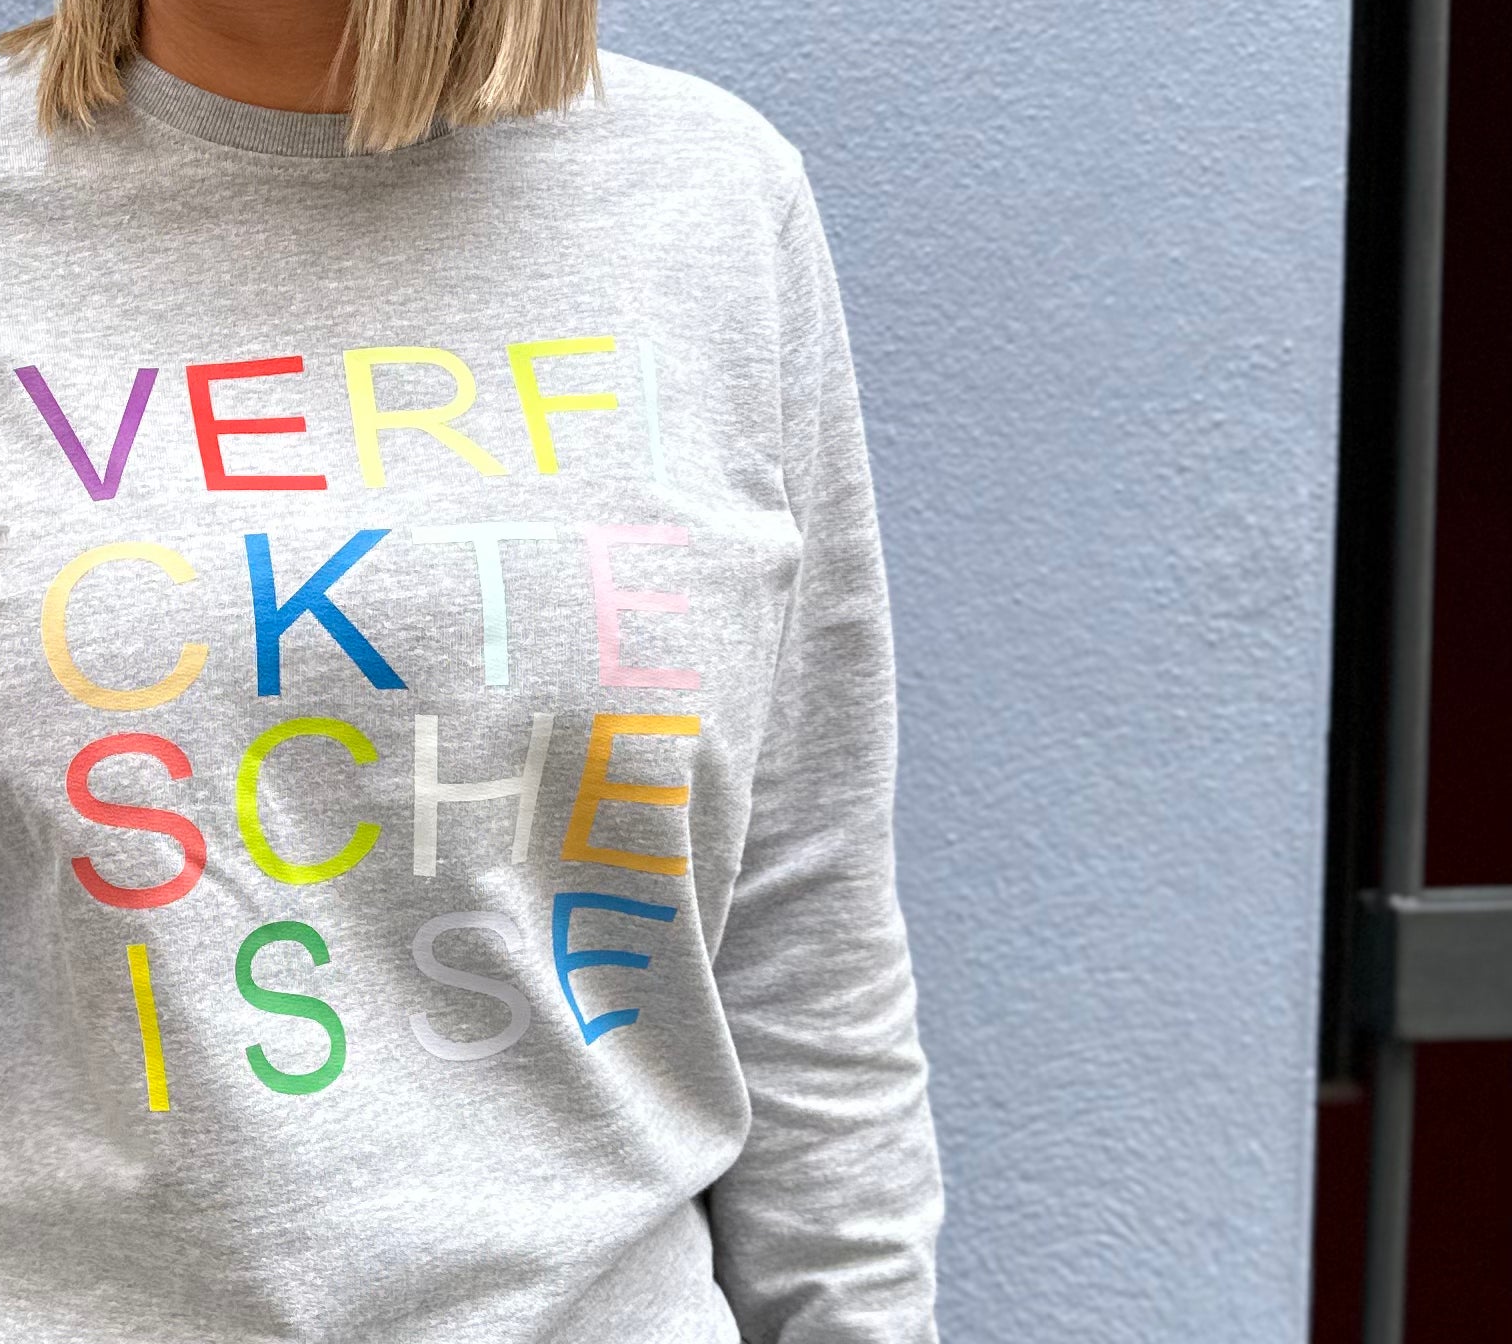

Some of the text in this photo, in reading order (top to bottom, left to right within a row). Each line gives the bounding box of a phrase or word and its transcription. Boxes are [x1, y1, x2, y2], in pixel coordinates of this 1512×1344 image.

[13, 334, 669, 502] VERFI
[40, 520, 701, 712] CKTE
[64, 712, 701, 911] SCHE
[125, 891, 678, 1113] ISSE
